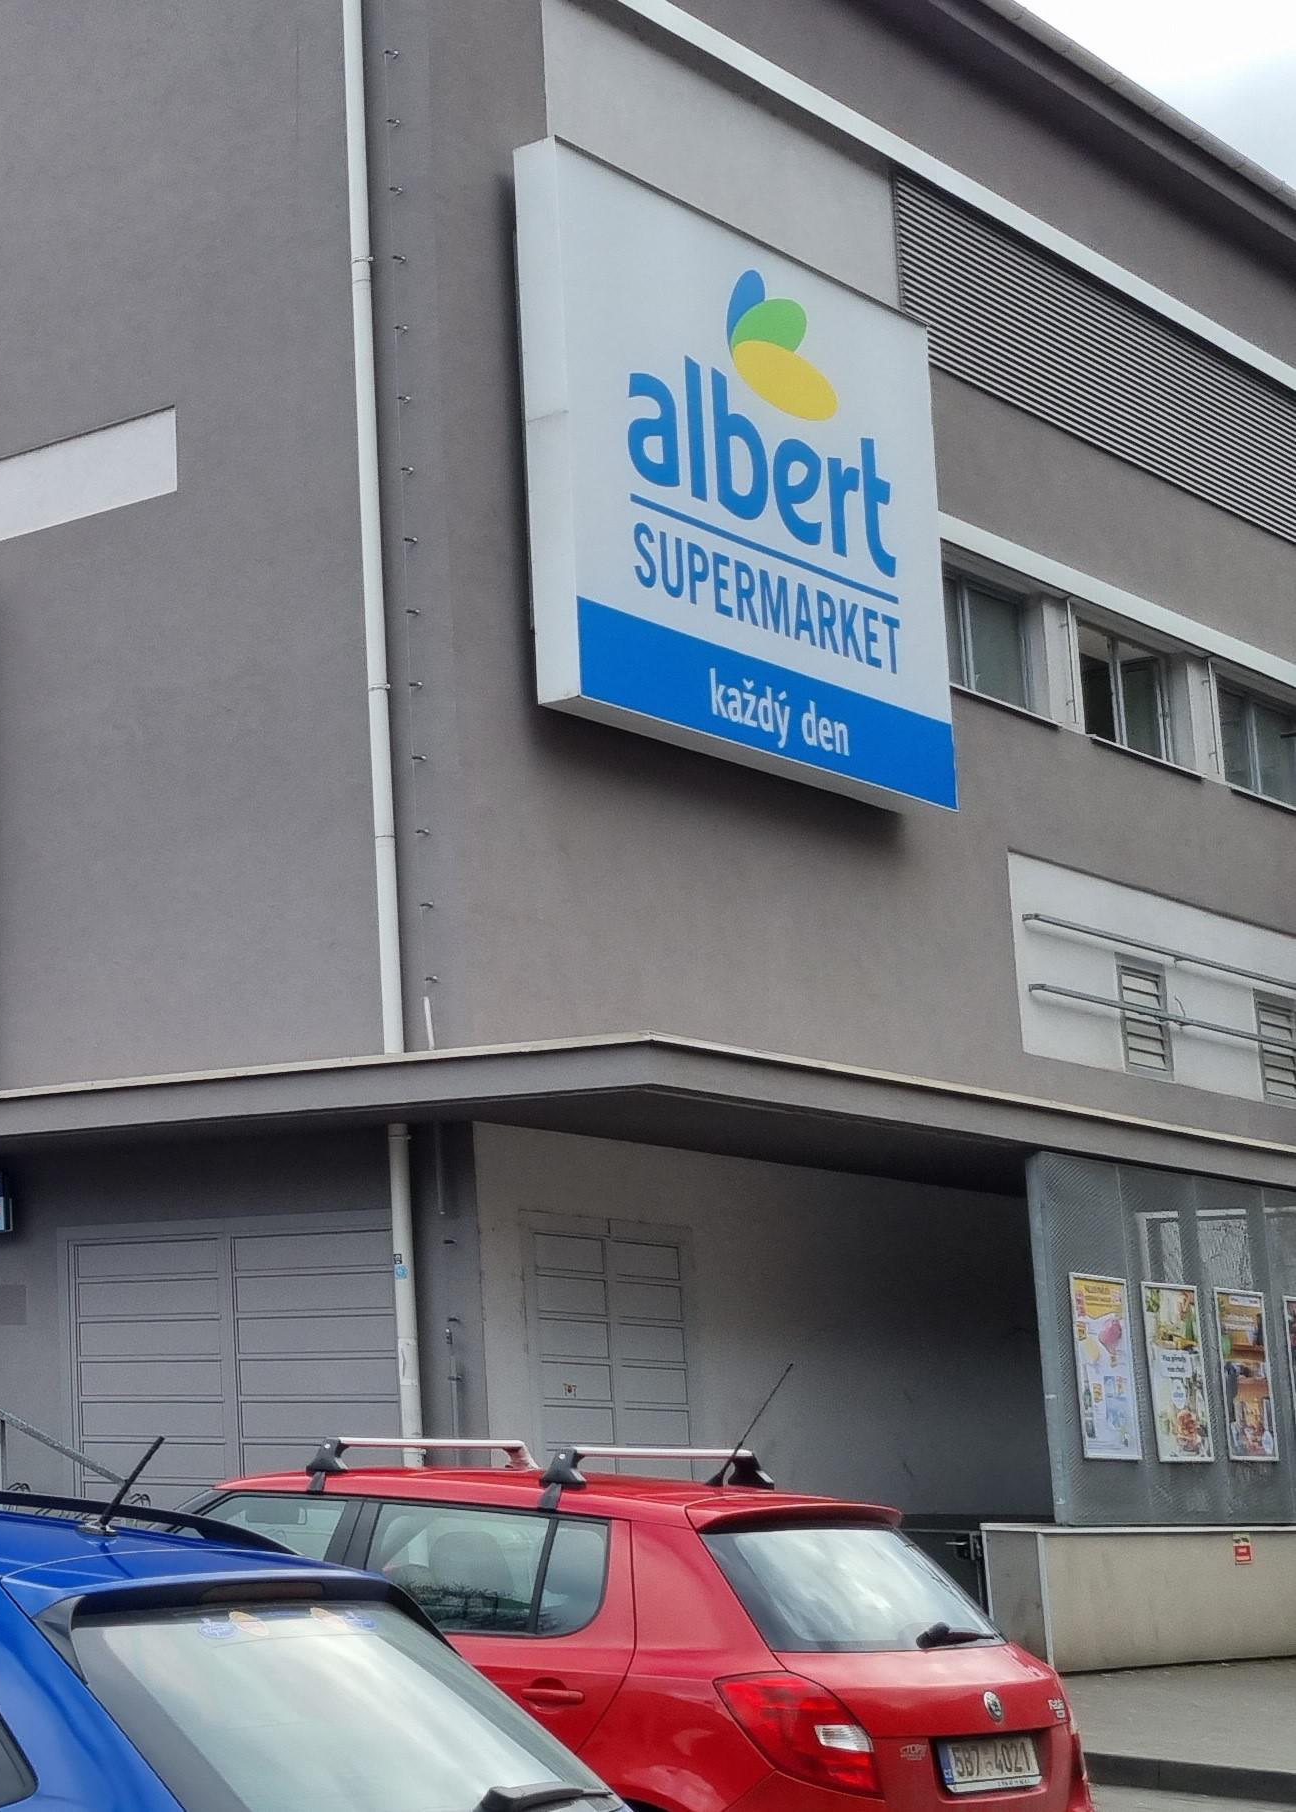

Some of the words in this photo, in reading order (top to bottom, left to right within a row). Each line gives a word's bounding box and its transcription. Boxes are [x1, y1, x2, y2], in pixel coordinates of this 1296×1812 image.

[627, 354, 897, 578] albert
[633, 521, 901, 675] SUPERMARKET
[709, 666, 791, 749] každý
[802, 701, 850, 757] den
